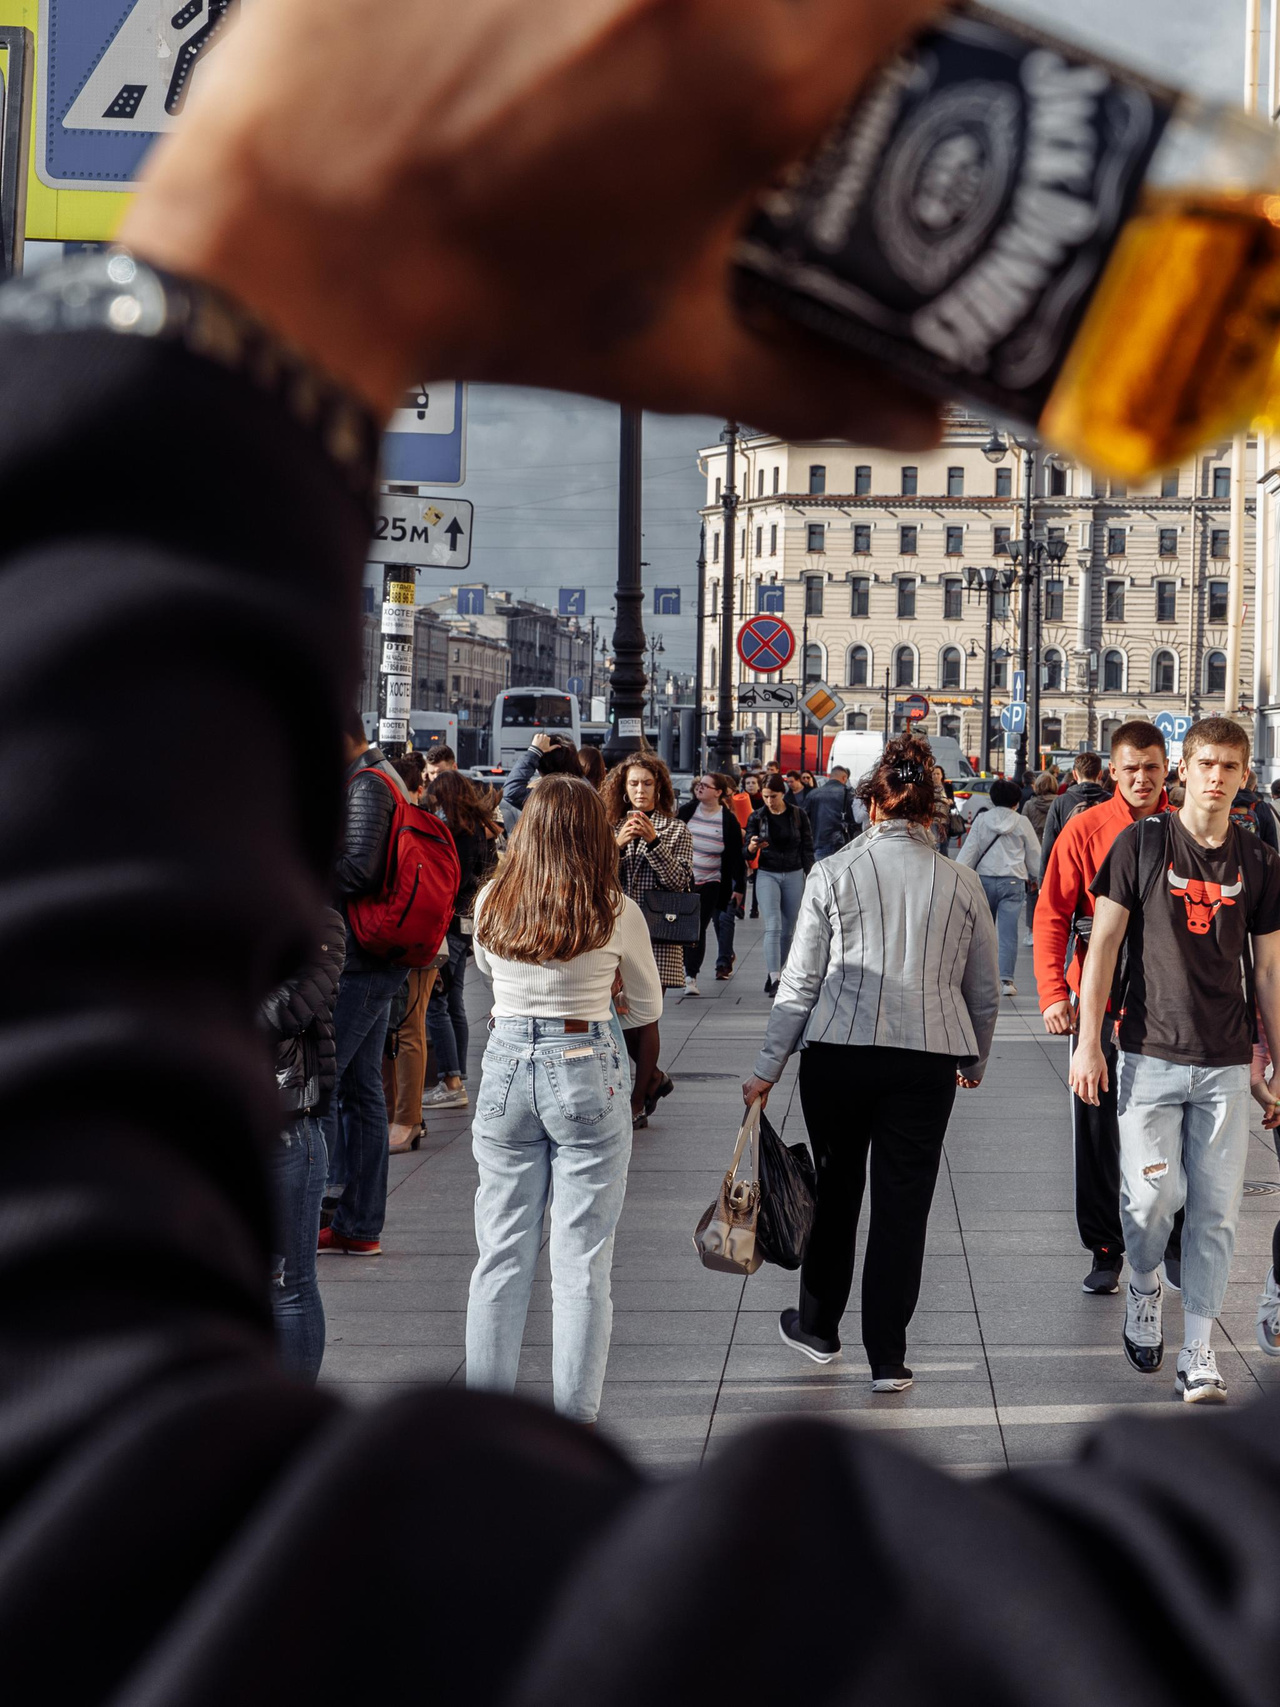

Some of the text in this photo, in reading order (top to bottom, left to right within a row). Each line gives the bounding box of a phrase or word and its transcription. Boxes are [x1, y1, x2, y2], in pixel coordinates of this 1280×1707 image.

[389, 682, 411, 697] ХОСТЕ
[1011, 706, 1022, 730] P
[1174, 718, 1187, 740] P
